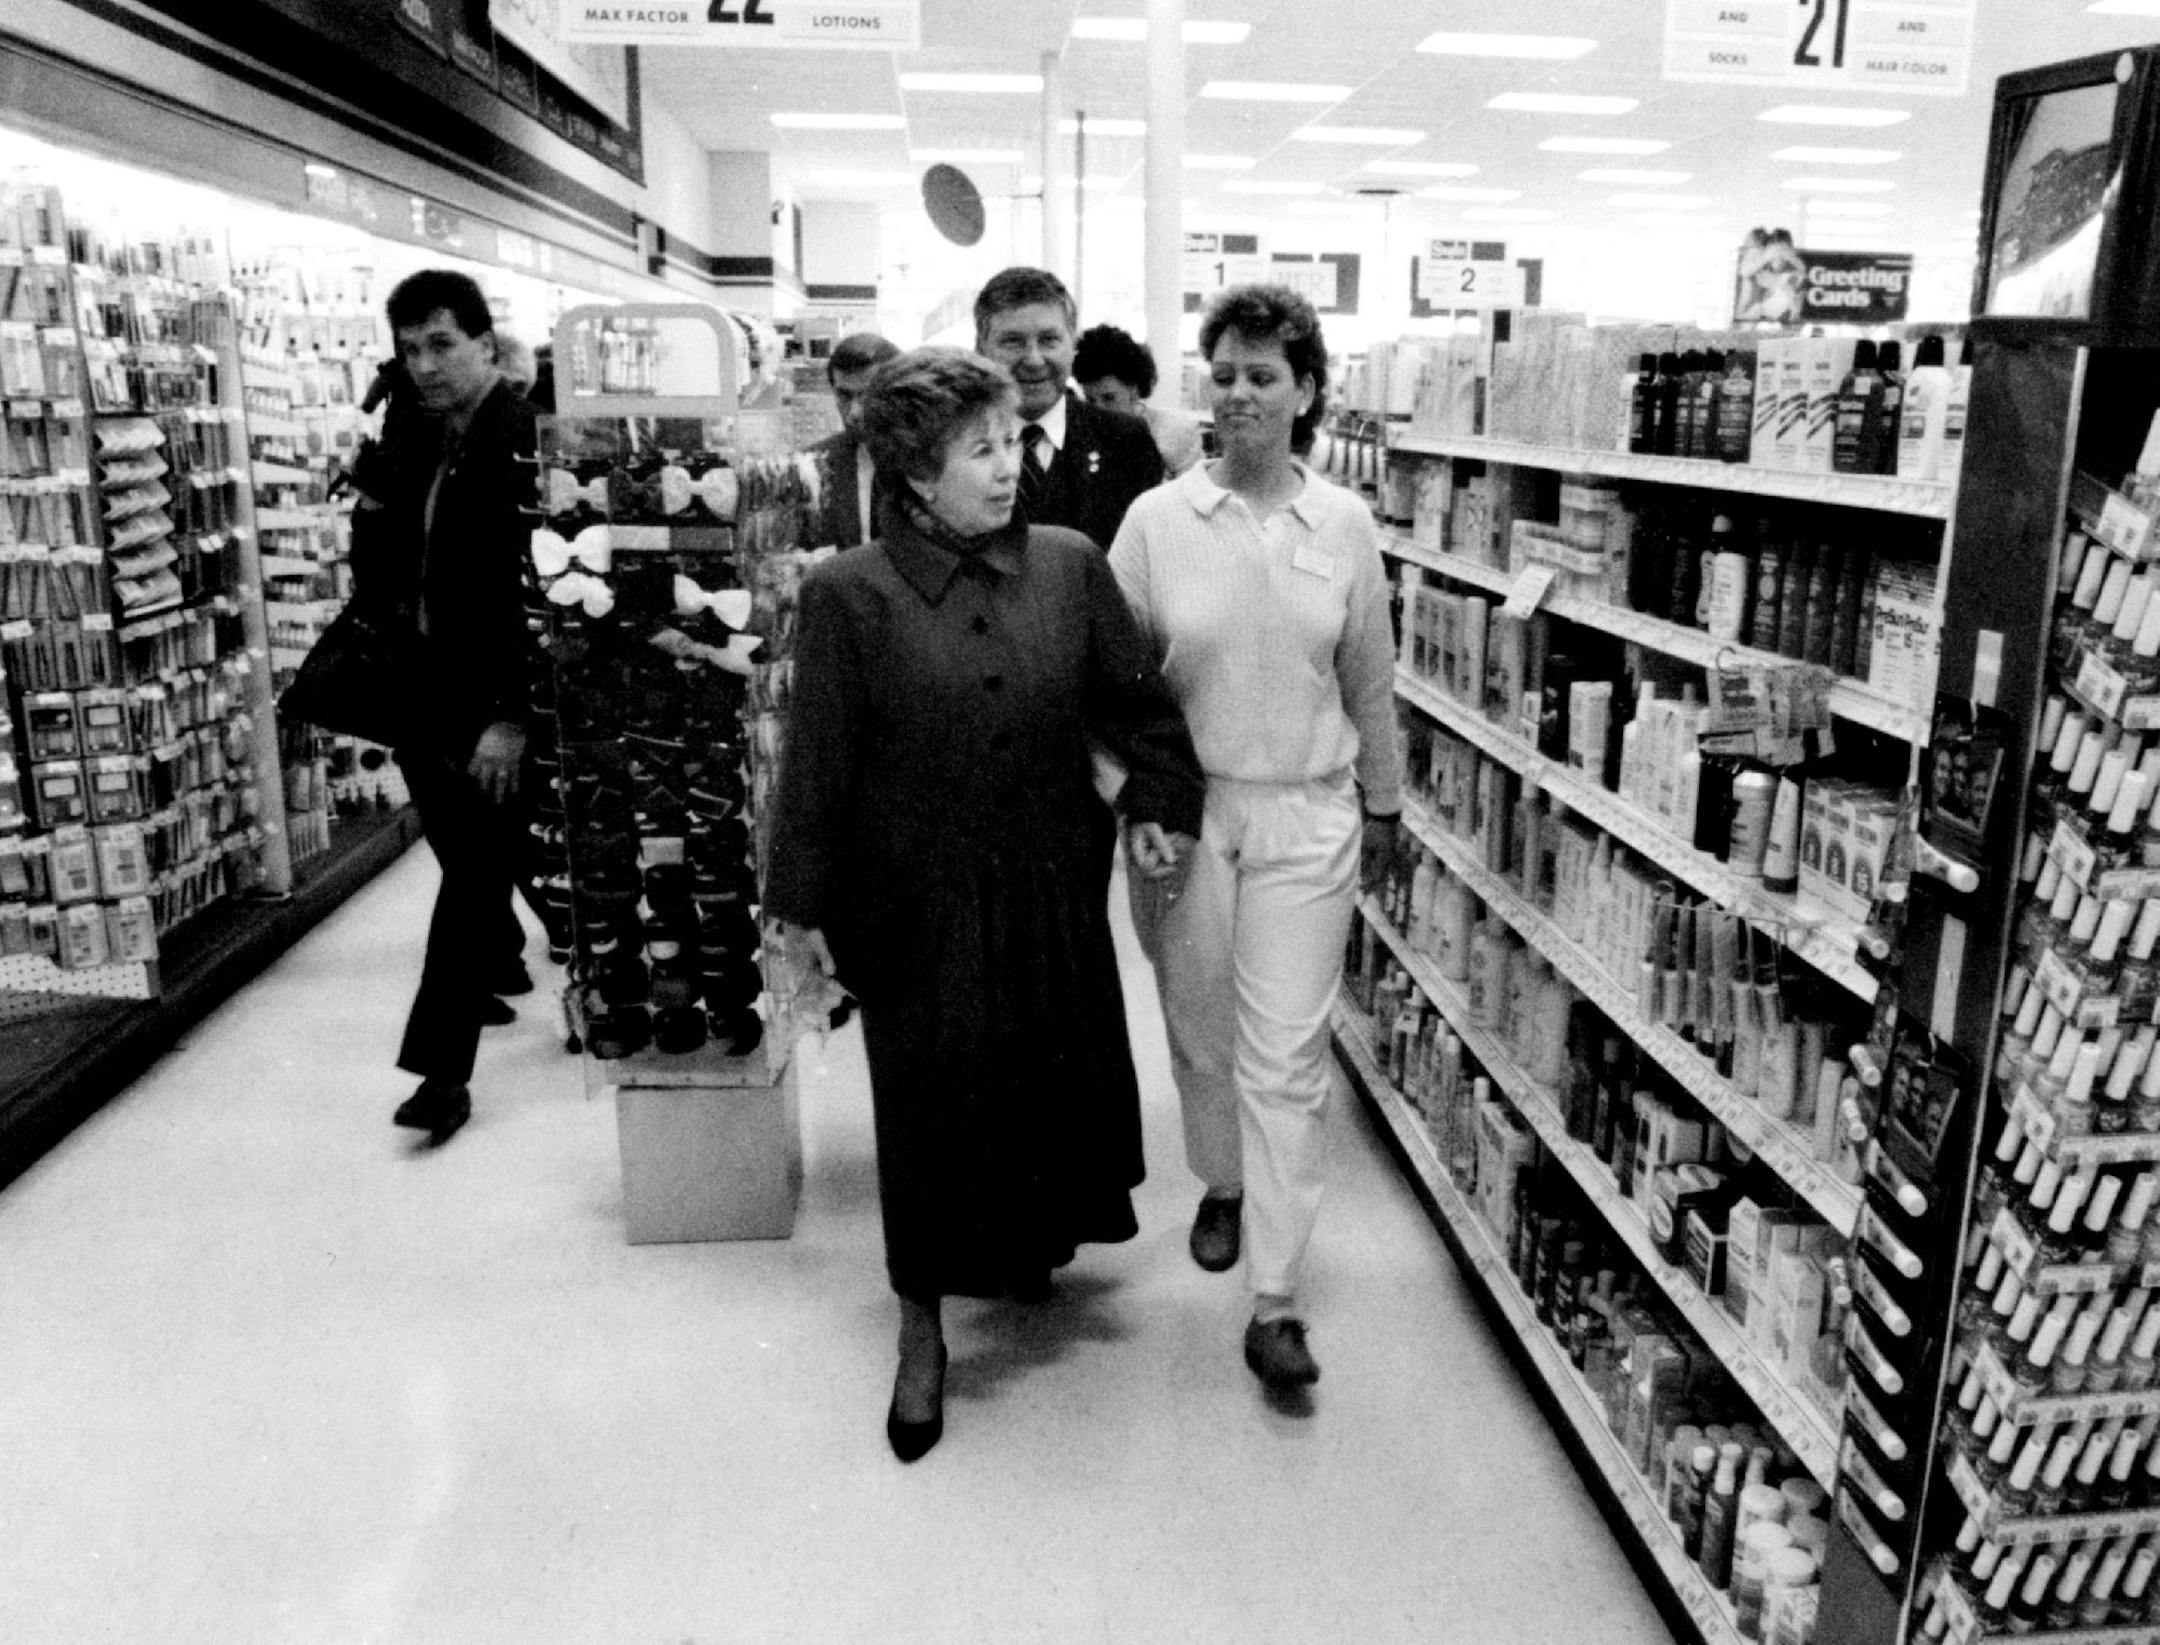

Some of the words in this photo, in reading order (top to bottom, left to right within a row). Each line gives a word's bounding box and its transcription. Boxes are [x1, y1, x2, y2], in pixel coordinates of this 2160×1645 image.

[585, 9, 621, 21] MAX
[627, 10, 689, 24] FACTOR
[812, 15, 881, 30] LOTIONS
[1718, 10, 1748, 23] AND
[1897, 21, 1927, 33] AND
[1708, 52, 1748, 66] SOCKS
[1866, 61, 1899, 72] HAIR
[1902, 62, 1948, 75] COLOR
[1214, 261, 1226, 286] 1
[1460, 267, 1476, 293] 2
[1808, 265, 1903, 292] Greeting
[1807, 286, 1871, 307] Cards
